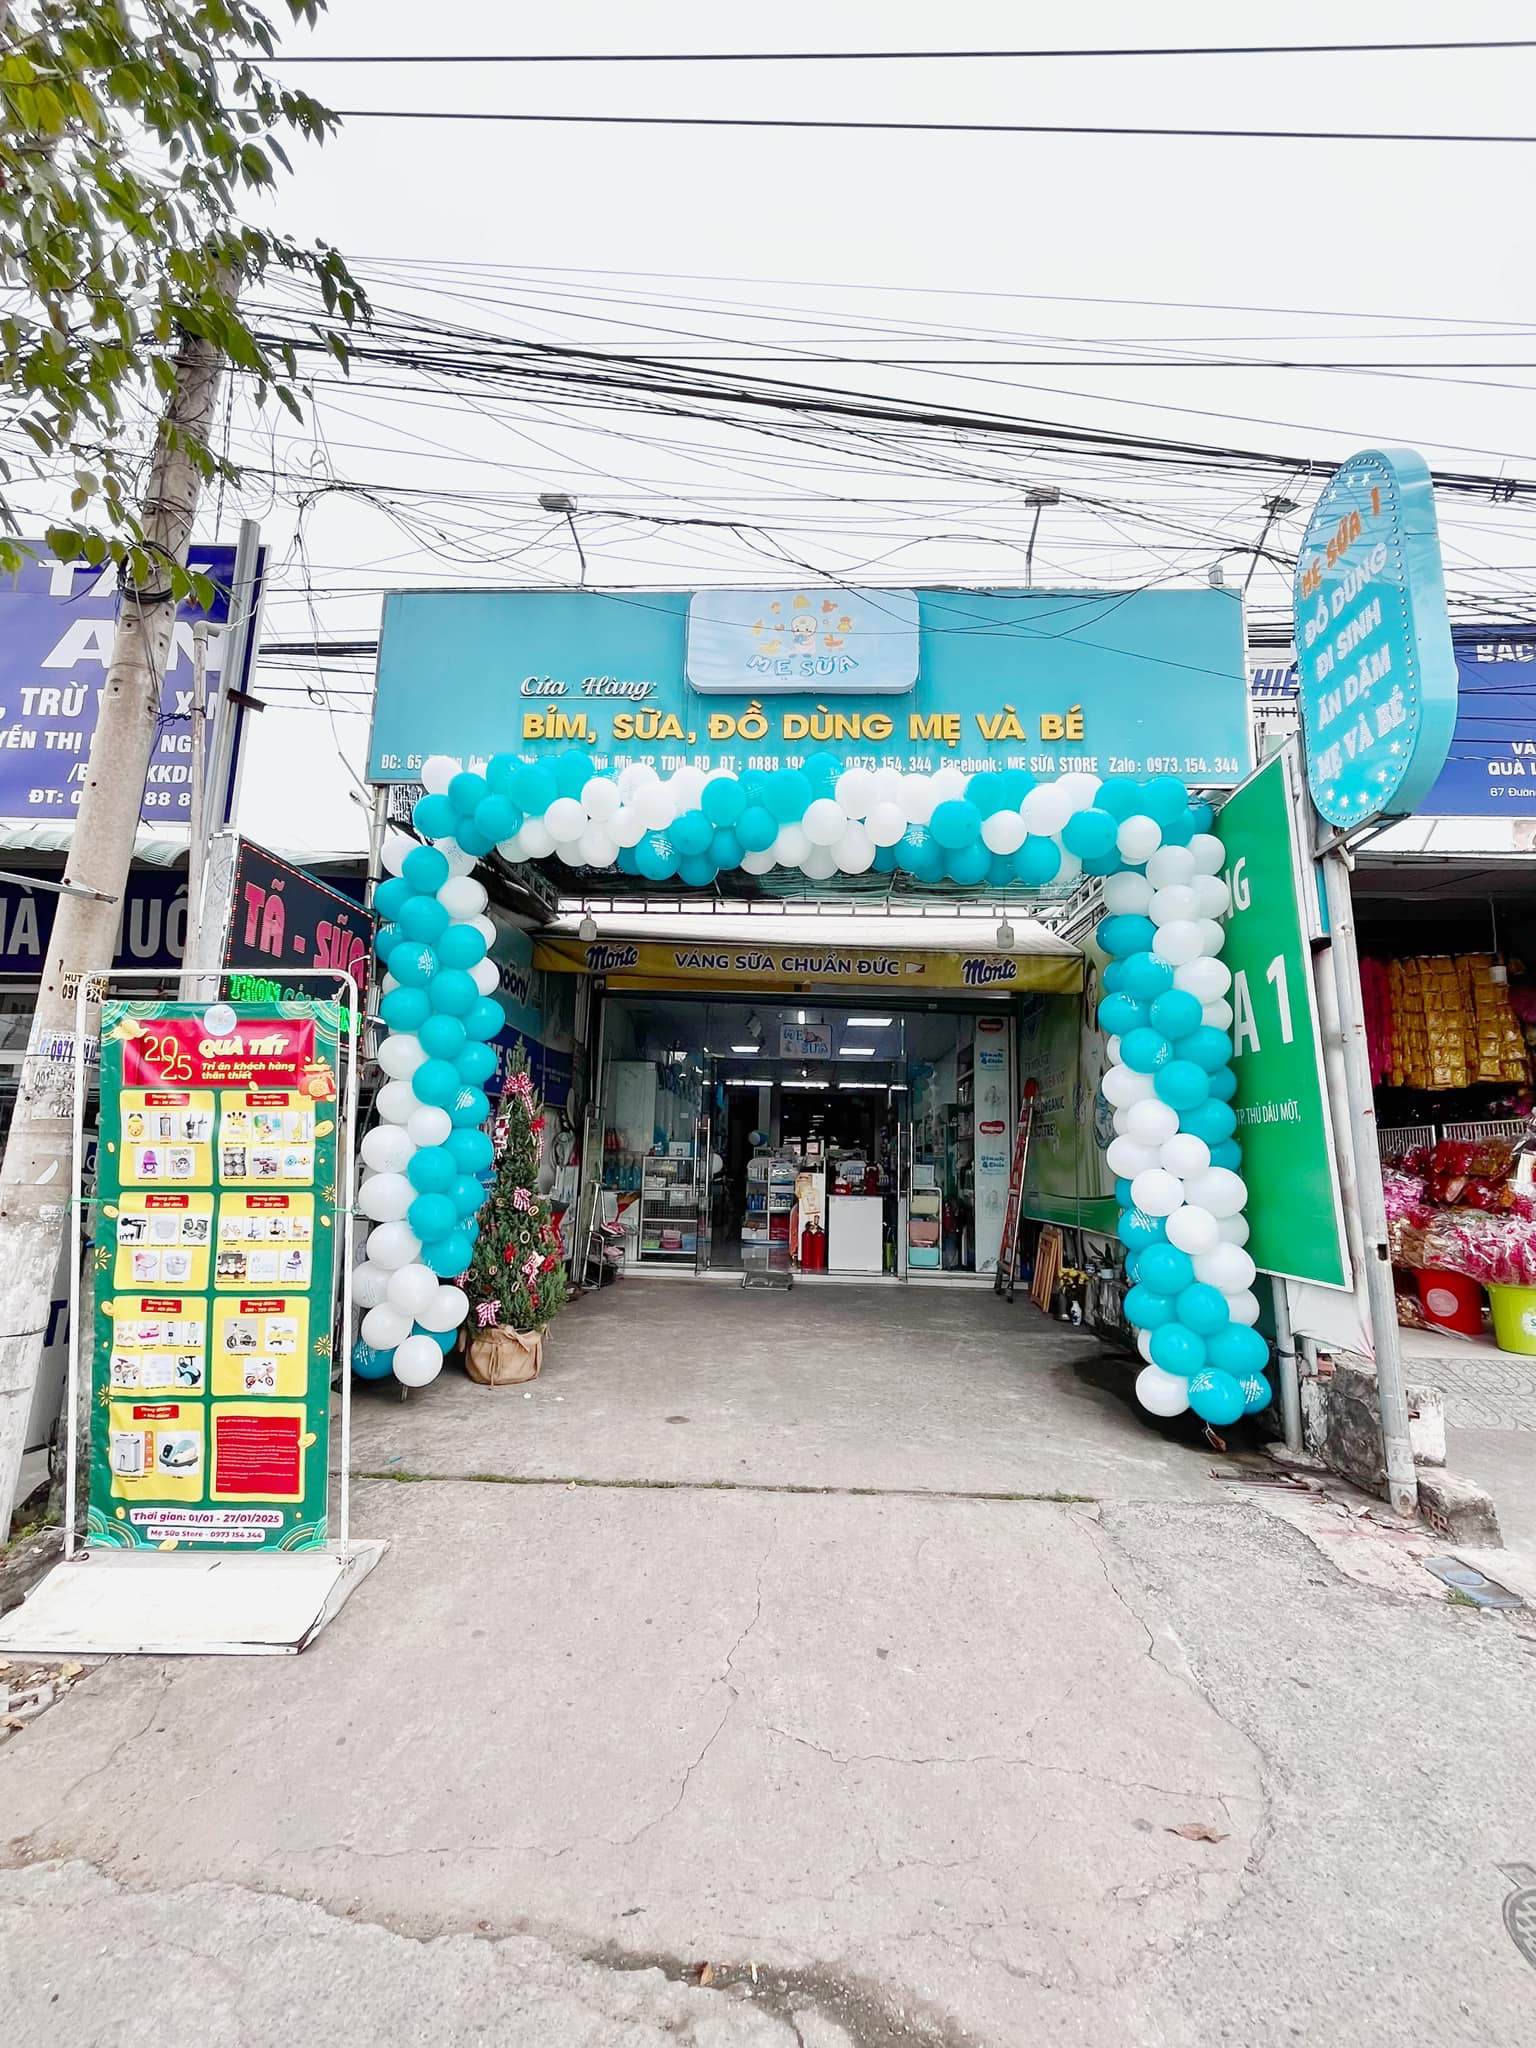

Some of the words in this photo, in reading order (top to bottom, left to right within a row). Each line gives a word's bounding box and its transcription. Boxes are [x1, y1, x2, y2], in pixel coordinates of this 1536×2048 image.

[1331, 542, 1388, 618] DÙNG
[1315, 644, 1335, 683] ĐI
[1336, 597, 1382, 661] SINH
[799, 654, 860, 677] SỮA
[1343, 642, 1392, 706] DẶM
[520, 674, 569, 696] Cửa
[20, 681, 88, 716] TRỪ
[612, 706, 697, 745] SỮA,
[708, 700, 769, 740] ĐỒ
[782, 704, 894, 741] DÙNG
[908, 713, 961, 747] MẸ
[975, 704, 1027, 741] VÀ
[1040, 704, 1084, 741] BÉ
[1343, 712, 1375, 759] VÀ
[44, 732, 83, 754] THỊ
[381, 754, 402, 769] ĐC:
[406, 754, 422, 769] 65
[1030, 753, 1055, 772] SỮA
[1059, 756, 1098, 773] STORE
[1108, 756, 1142, 773] Zalo:
[1487, 758, 1526, 776] QUÀ
[29, 789, 64, 804] ĐT:
[244, 879, 287, 958] TÃ
[586, 944, 640, 970] Monte
[674, 949, 729, 969] VÁNG
[734, 952, 776, 972] SỮA
[780, 952, 852, 975] CHUẨN
[856, 956, 900, 976] ĐỨC
[962, 956, 1018, 986] Monte
[1266, 953, 1294, 1045] 1
[198, 1034, 245, 1059] QUÀ
[248, 1033, 290, 1056] TẾT
[201, 1062, 216, 1071] Tri
[217, 1062, 231, 1071] ân
[233, 1061, 266, 1071] khách
[267, 1062, 296, 1073] hàng
[201, 1071, 226, 1080] thân
[227, 1070, 252, 1080] thiết
[1245, 1102, 1262, 1125] THỦ
[1280, 1098, 1302, 1125] MỘT,
[132, 1511, 158, 1521] Thời
[159, 1512, 186, 1523] gian:
[188, 1513, 213, 1523] 01/01
[223, 1513, 280, 1524] 27/01/2025
[181, 1529, 203, 1538] Store
[210, 1530, 229, 1538] 0973
[231, 1530, 245, 1538] 154
